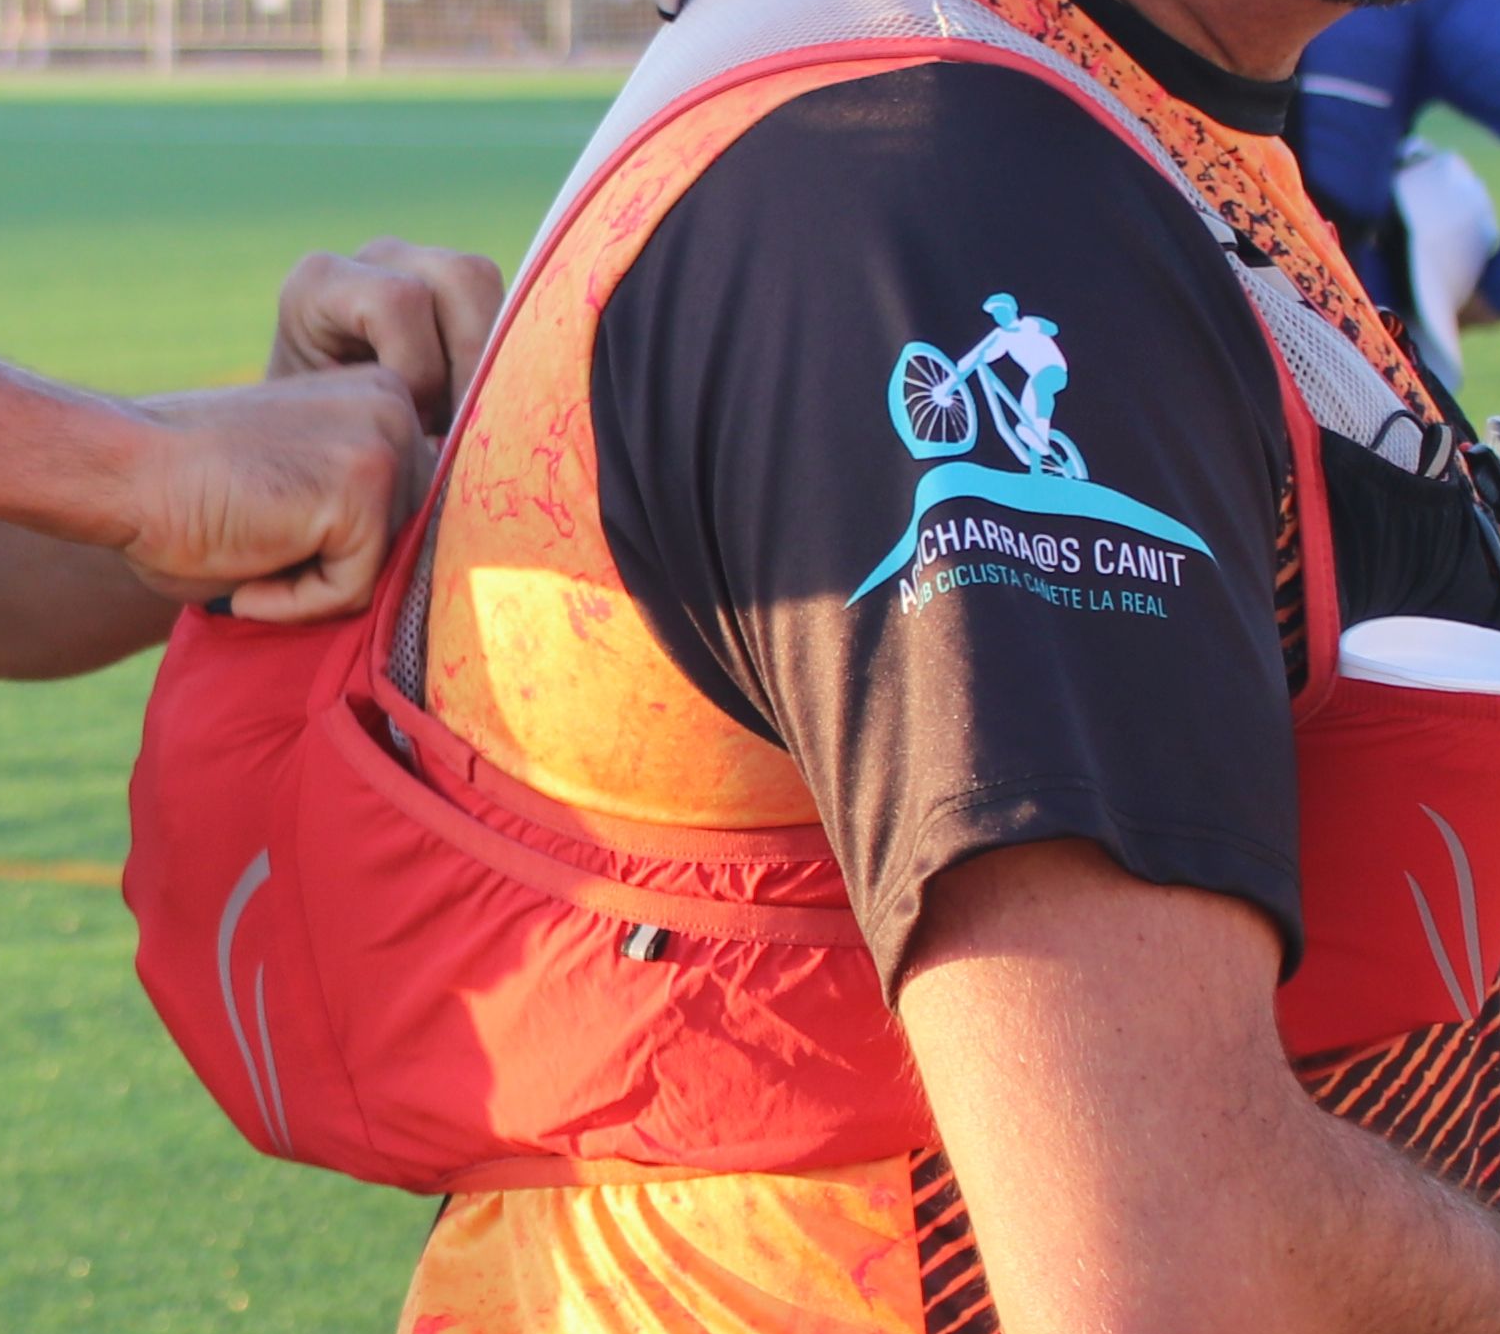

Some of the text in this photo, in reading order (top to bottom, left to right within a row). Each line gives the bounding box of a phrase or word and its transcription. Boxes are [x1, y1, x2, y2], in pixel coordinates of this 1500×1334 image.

[1095, 537, 1186, 587] CANIT
[935, 563, 1022, 594] CICLISTA
[1089, 589, 1115, 611] LA
[1121, 590, 1169, 619] REAL
